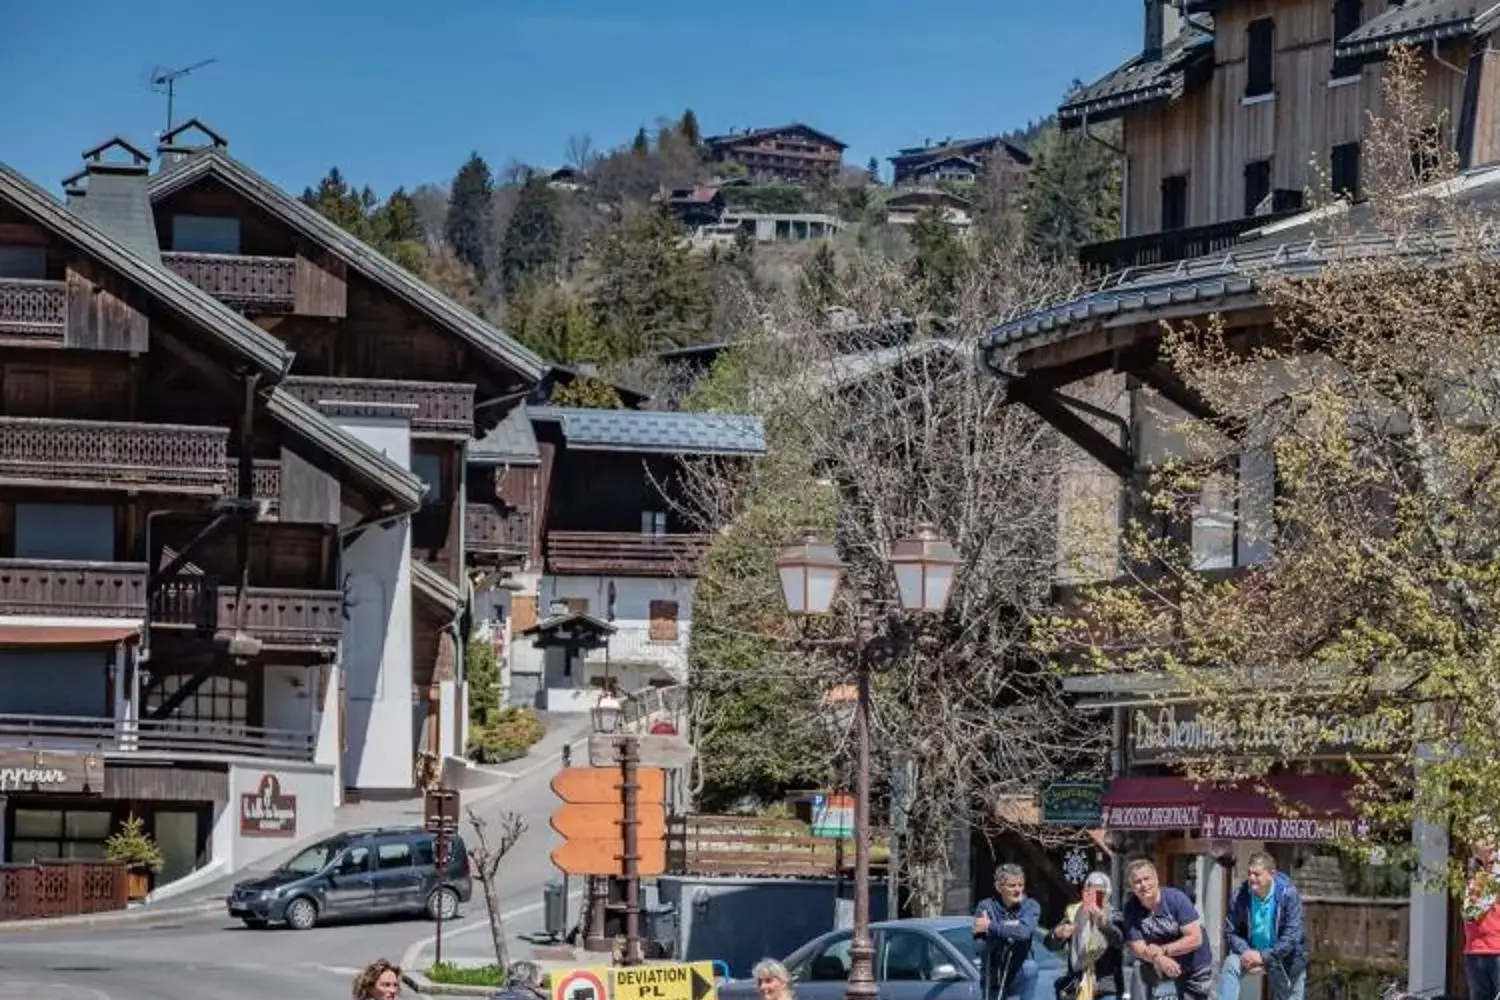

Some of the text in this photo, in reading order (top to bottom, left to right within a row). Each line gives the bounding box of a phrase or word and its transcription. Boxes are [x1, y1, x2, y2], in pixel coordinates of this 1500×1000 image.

[1217, 814, 1278, 837] PRODUITS
[617, 968, 687, 984] DEVIATION
[639, 985, 665, 997] PL
